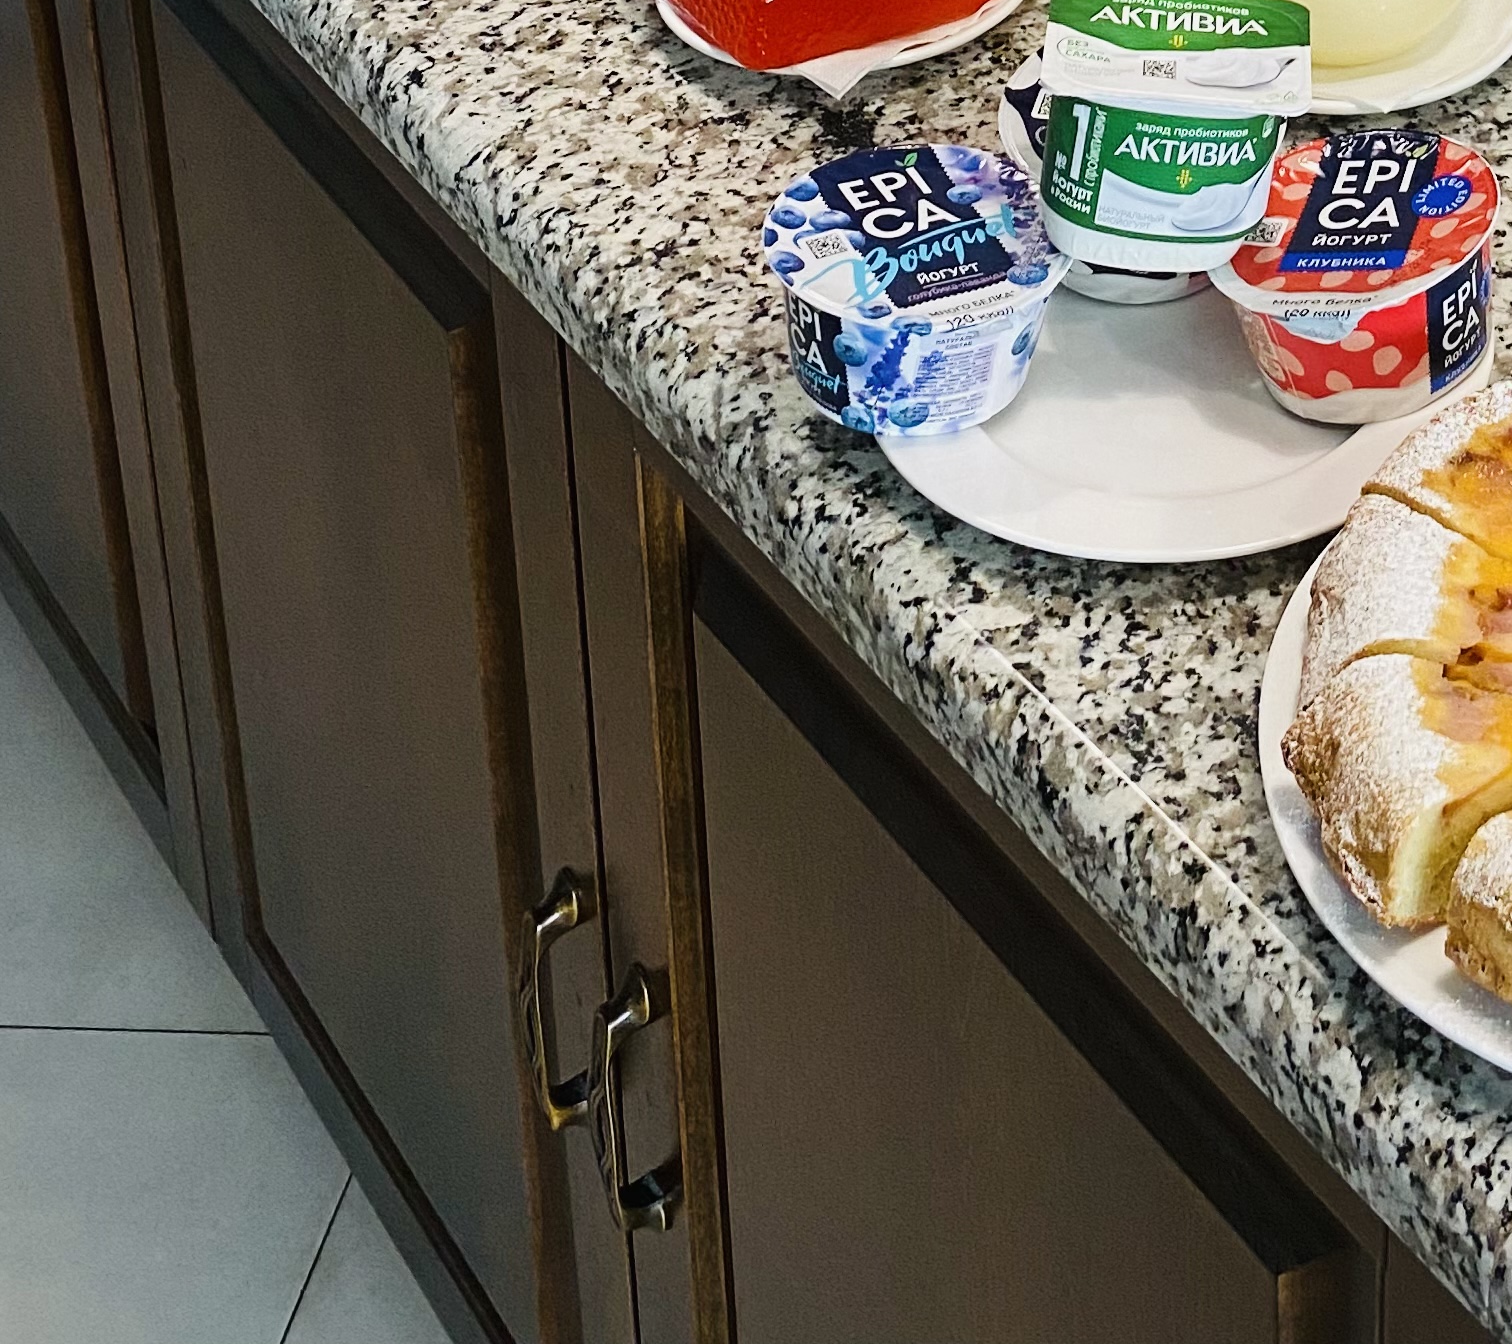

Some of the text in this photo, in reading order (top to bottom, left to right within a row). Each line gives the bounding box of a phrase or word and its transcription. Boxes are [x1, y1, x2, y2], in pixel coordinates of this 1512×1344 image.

[1089, 5, 1269, 36] АКТИВИА
[1065, 48, 1111, 63] САХАРА
[1066, 37, 1089, 48] БЕЗ
[1069, 103, 1092, 182] 1
[1135, 121, 1249, 139] заряд пробиотиков
[1113, 133, 1257, 167] АКТИВИА
[837, 165, 933, 212] EPI
[1331, 158, 1418, 195] EPI
[1415, 175, 1465, 205] LIMITED
[861, 197, 962, 240] CA
[1317, 196, 1400, 231] CA
[1420, 188, 1469, 216] EDITION
[820, 203, 1017, 307] Bouquet
[1311, 232, 1392, 247] ЙОГУРТ
[915, 260, 981, 286] ЙОГУРТ
[1296, 255, 1387, 268] КЛУБНИКА
[1441, 267, 1478, 326] EPI
[789, 293, 823, 342] EPI
[1441, 308, 1481, 352] CA
[789, 324, 829, 376] CA
